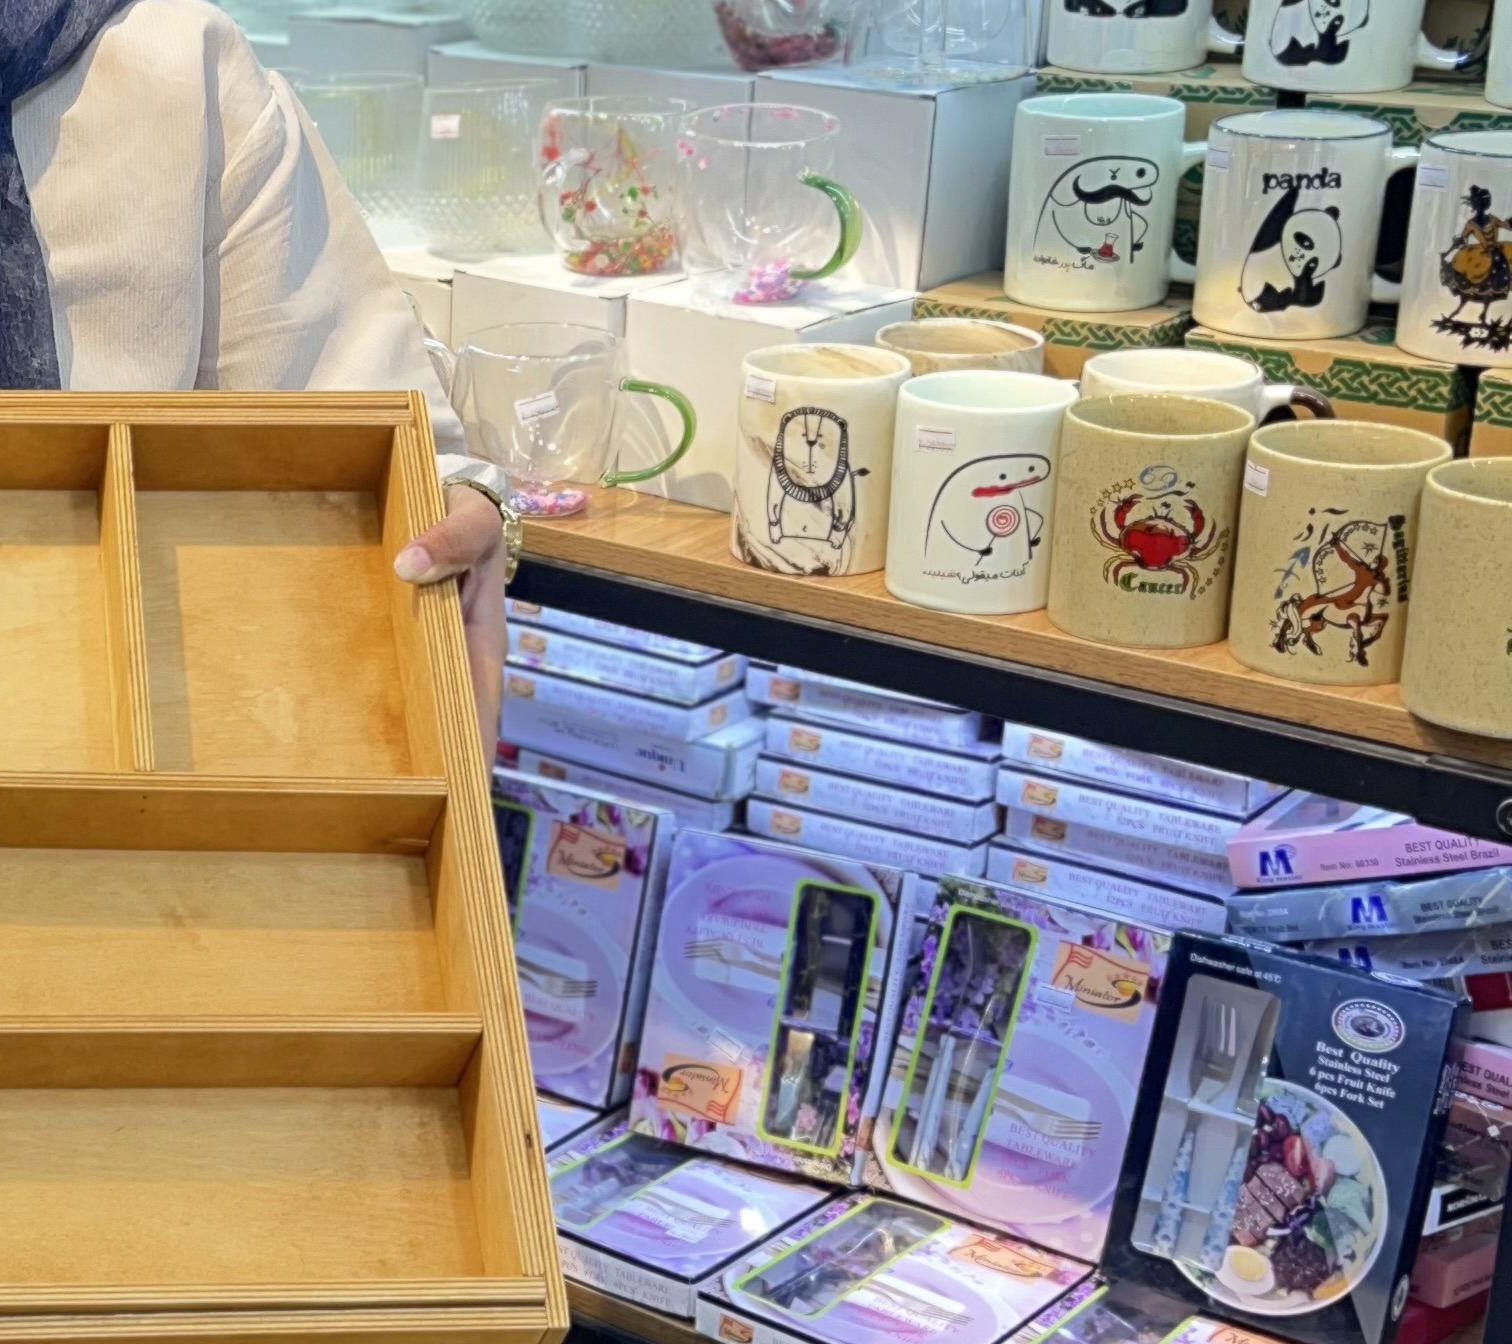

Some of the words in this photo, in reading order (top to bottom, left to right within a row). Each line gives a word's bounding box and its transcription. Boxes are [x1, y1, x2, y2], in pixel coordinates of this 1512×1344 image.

[1262, 167, 1341, 195] panda
[1119, 571, 1186, 594] Cancer
[1394, 854, 1441, 868] Stainless
[1442, 850, 1469, 863] Steel
[1470, 847, 1501, 861] Brazil
[1405, 841, 1432, 854] BEST
[1434, 836, 1481, 851] QUALITY
[1490, 939, 1512, 951] BES
[1065, 973, 1122, 1005] Miniator
[1316, 1040, 1344, 1058] Best
[1350, 1051, 1401, 1075] Quality
[1317, 1055, 1362, 1075] Stainless
[1364, 1067, 1390, 1083] Steel
[1309, 1066, 1317, 1077] 6
[1317, 1070, 1336, 1082] pcs
[1337, 1074, 1365, 1090] Fruit
[1366, 1081, 1396, 1098] Knife
[1314, 1081, 1338, 1096] 6pcs
[1339, 1087, 1365, 1104] Fork
[1367, 1095, 1385, 1109] Set
